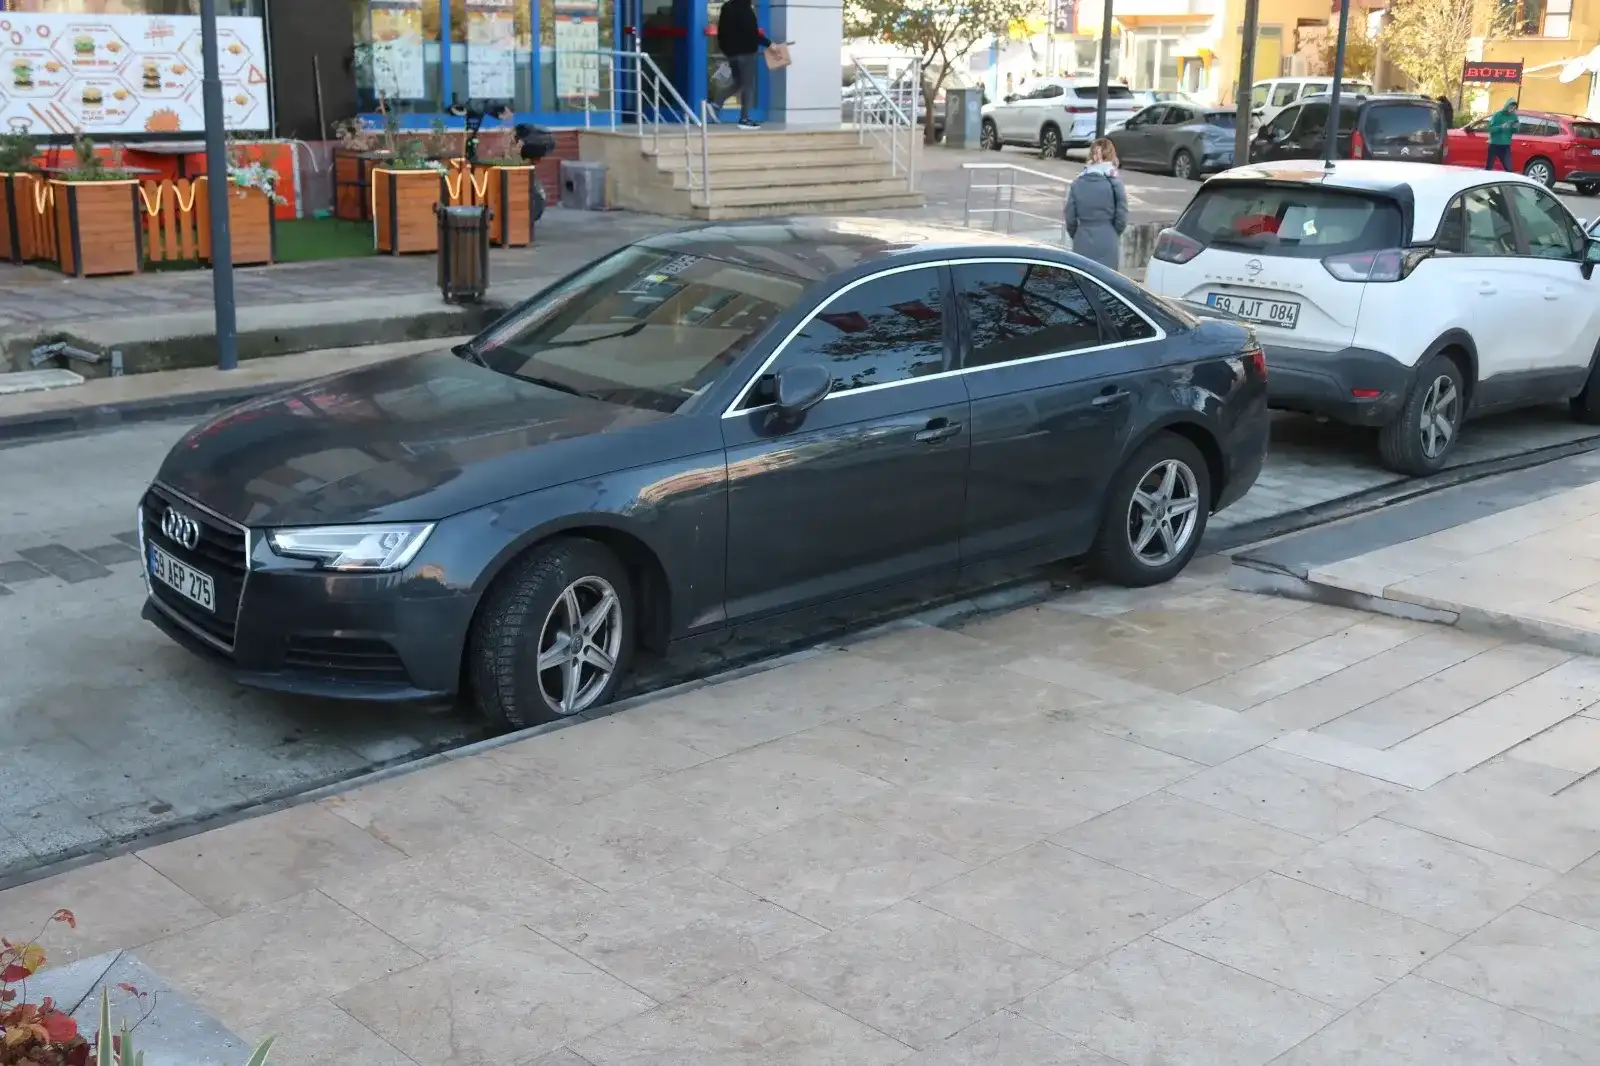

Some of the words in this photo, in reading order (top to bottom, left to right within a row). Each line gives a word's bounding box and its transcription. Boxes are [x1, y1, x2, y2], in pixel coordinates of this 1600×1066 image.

[1215, 297, 1231, 312] 59
[1238, 300, 1264, 317] AJT
[1270, 304, 1294, 322] 084
[154, 549, 165, 577] 59
[168, 559, 185, 590] AEP
[189, 572, 211, 605] 275
